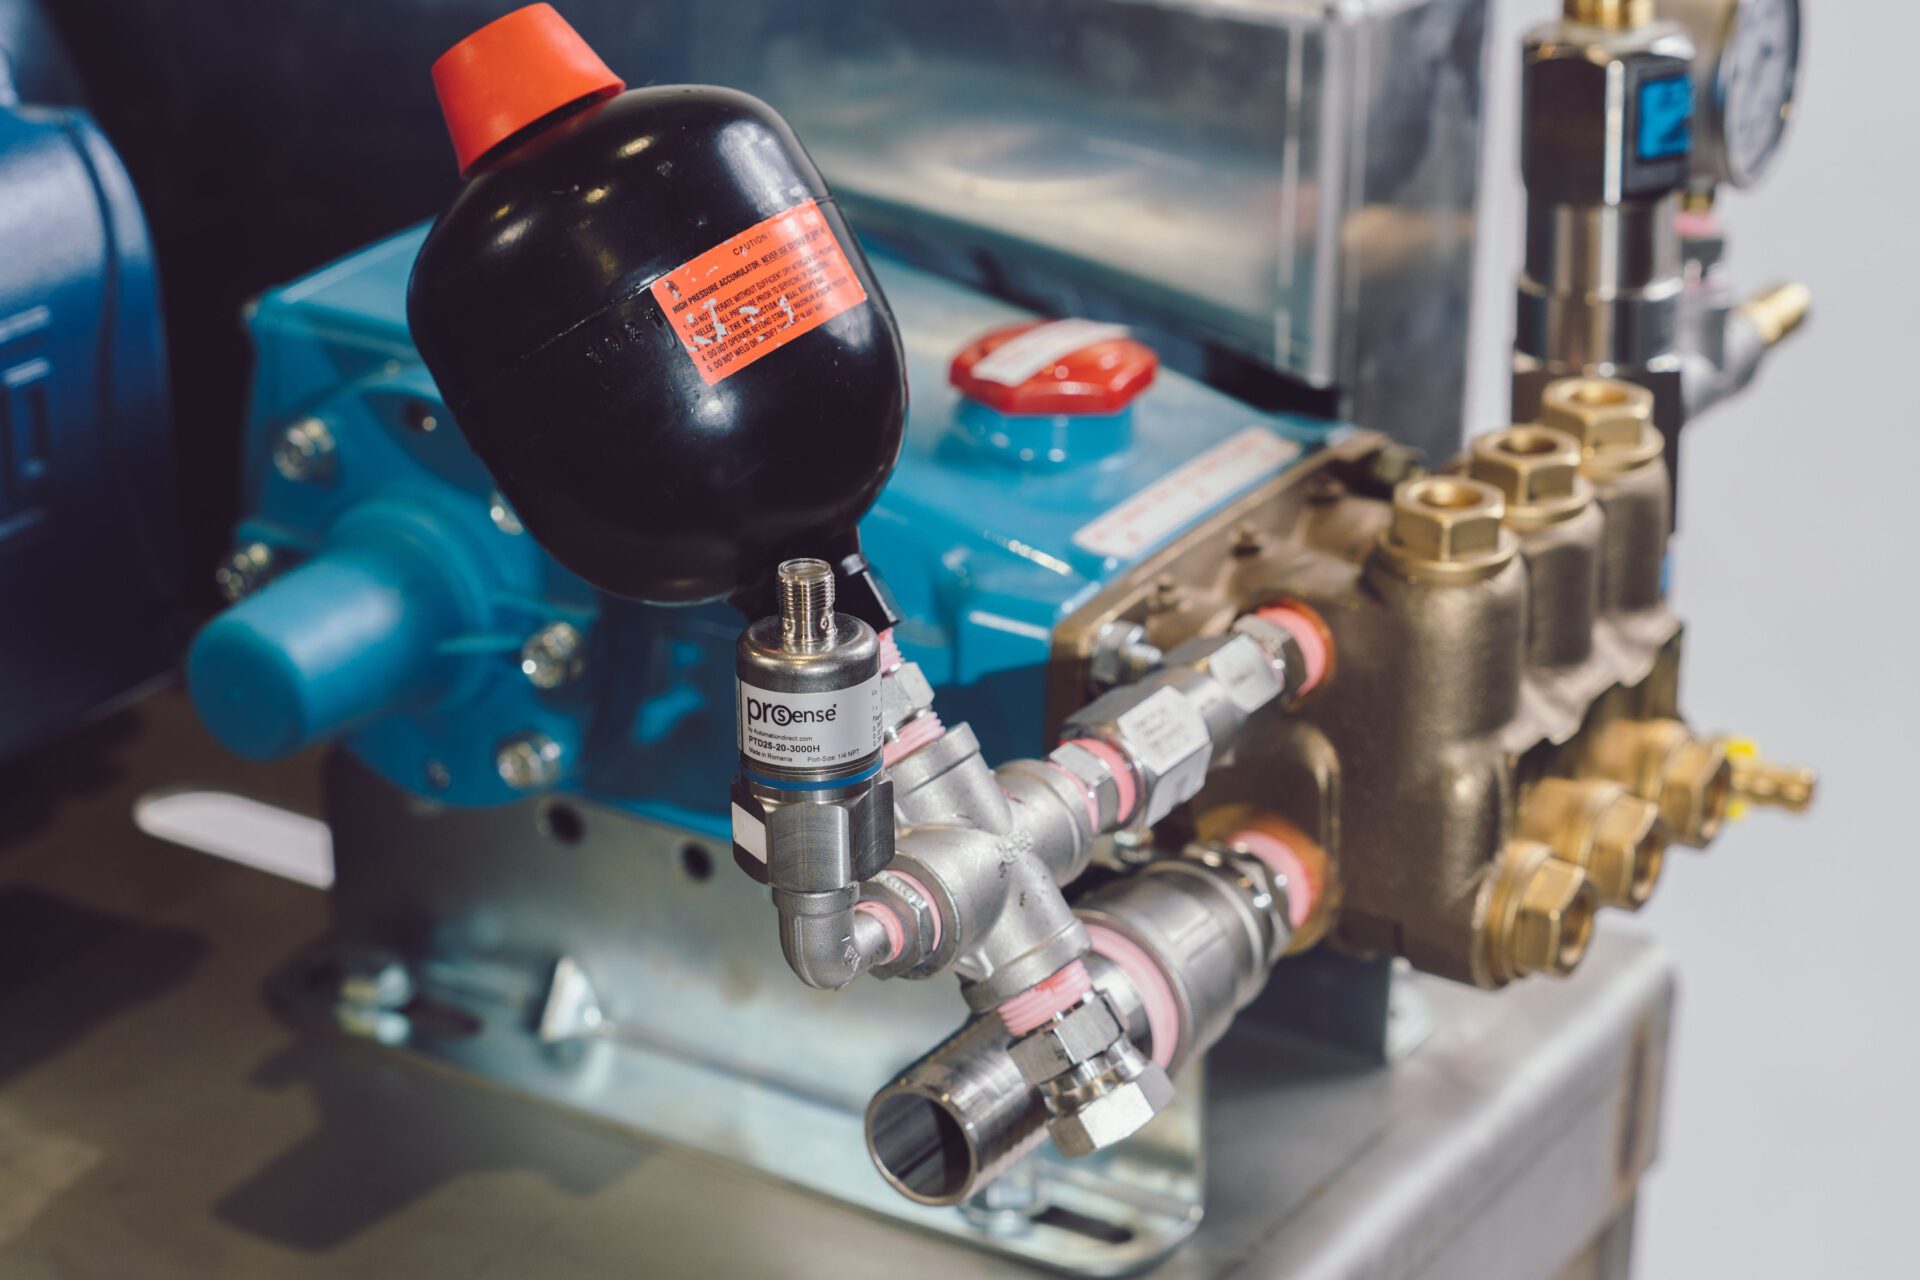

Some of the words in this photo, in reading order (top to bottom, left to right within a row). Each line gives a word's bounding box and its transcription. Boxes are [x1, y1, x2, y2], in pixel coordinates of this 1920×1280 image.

[731, 232, 768, 256] CAUTION
[671, 299, 688, 313] HIGH
[687, 282, 719, 304] PRESSURE
[760, 249, 778, 263] NEVER
[697, 310, 710, 322] NOT
[708, 297, 733, 316] PERATE
[732, 284, 756, 302] WITHOUT
[755, 271, 782, 289] SUFFICIENT
[718, 313, 730, 324] ALL
[755, 289, 772, 303] PRIOR
[770, 286, 779, 295] TO
[707, 348, 717, 358] DO
[715, 341, 729, 353] NOT
[727, 328, 751, 346] OPERATE
[750, 316, 772, 333] BEYOND
[728, 320, 741, 331] THE
[712, 358, 723, 368] DO
[721, 351, 734, 363] NOT
[733, 342, 750, 356] WELD
[748, 337, 759, 347] OR
[749, 735, 820, 752] PTD25-20-3000H
[848, 748, 860, 757] NPT
[767, 753, 793, 762] Romania
